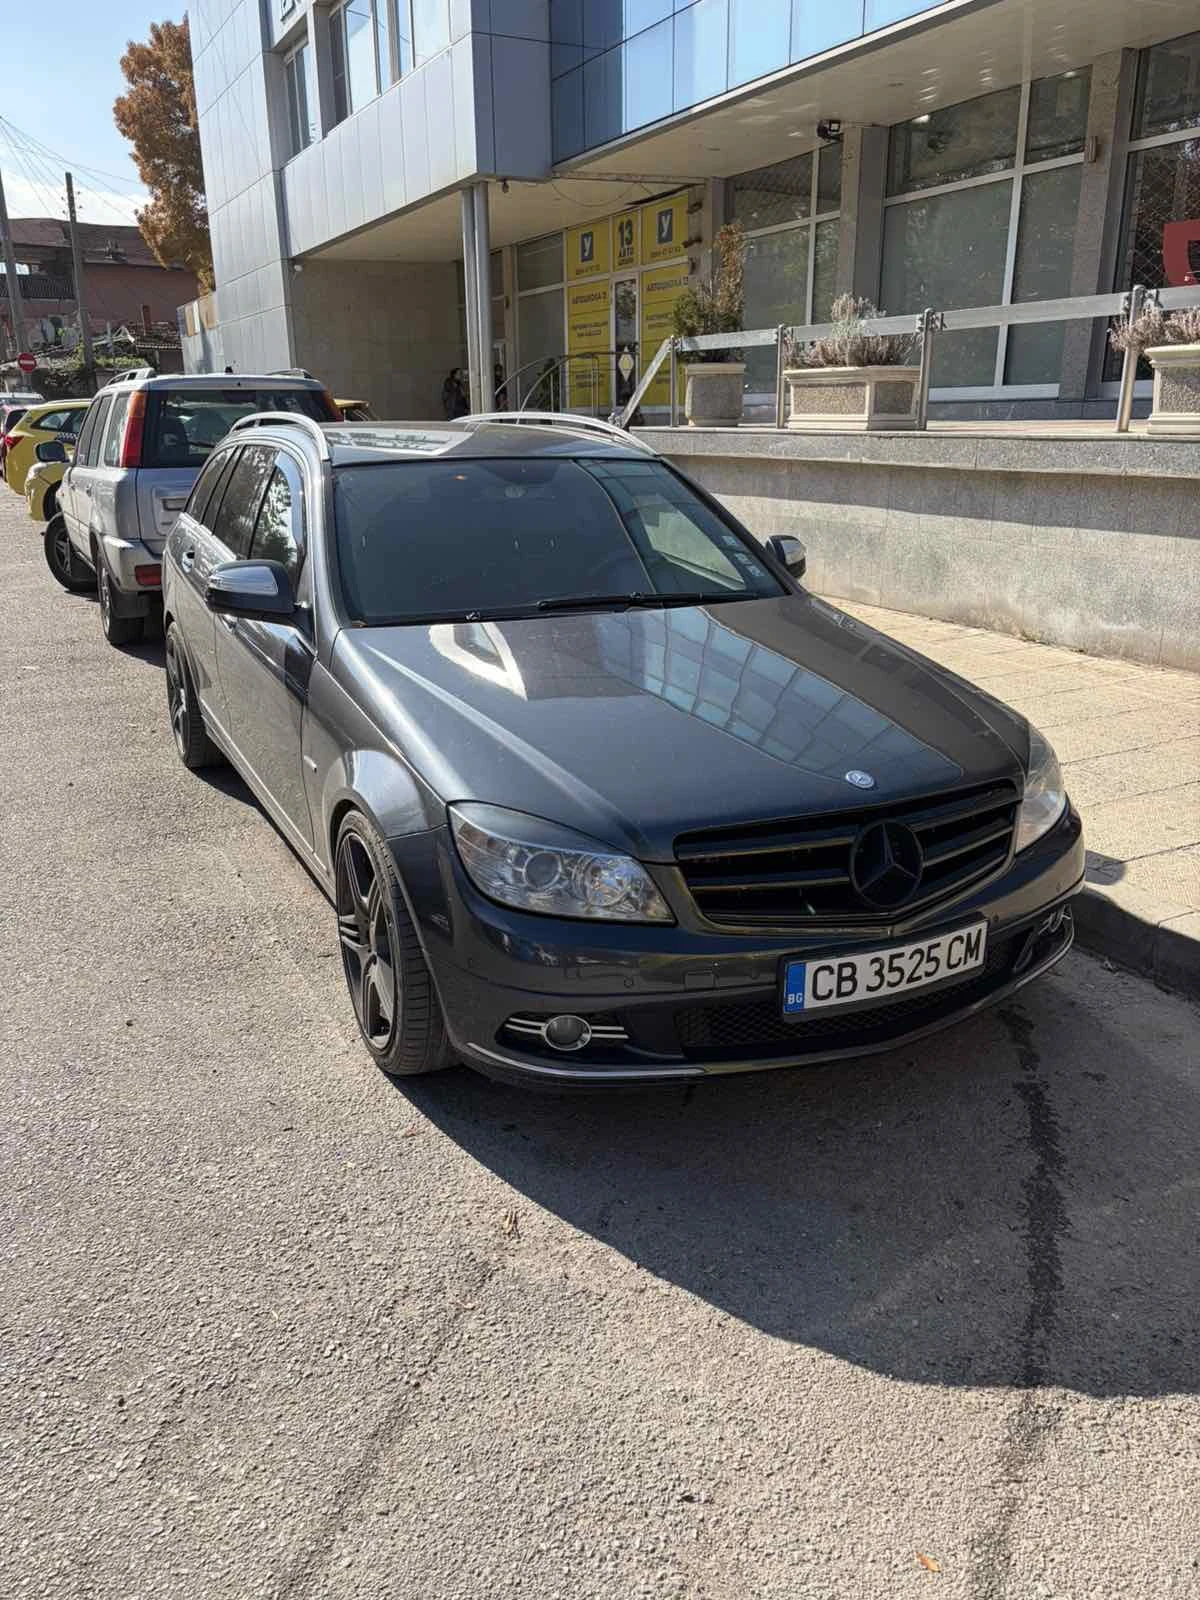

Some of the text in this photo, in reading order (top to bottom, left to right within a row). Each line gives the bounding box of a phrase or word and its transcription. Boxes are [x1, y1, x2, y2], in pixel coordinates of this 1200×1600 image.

[618, 219, 633, 248] 13
[812, 928, 982, 1001] CB 3525 CM
[787, 993, 803, 1005] BG
